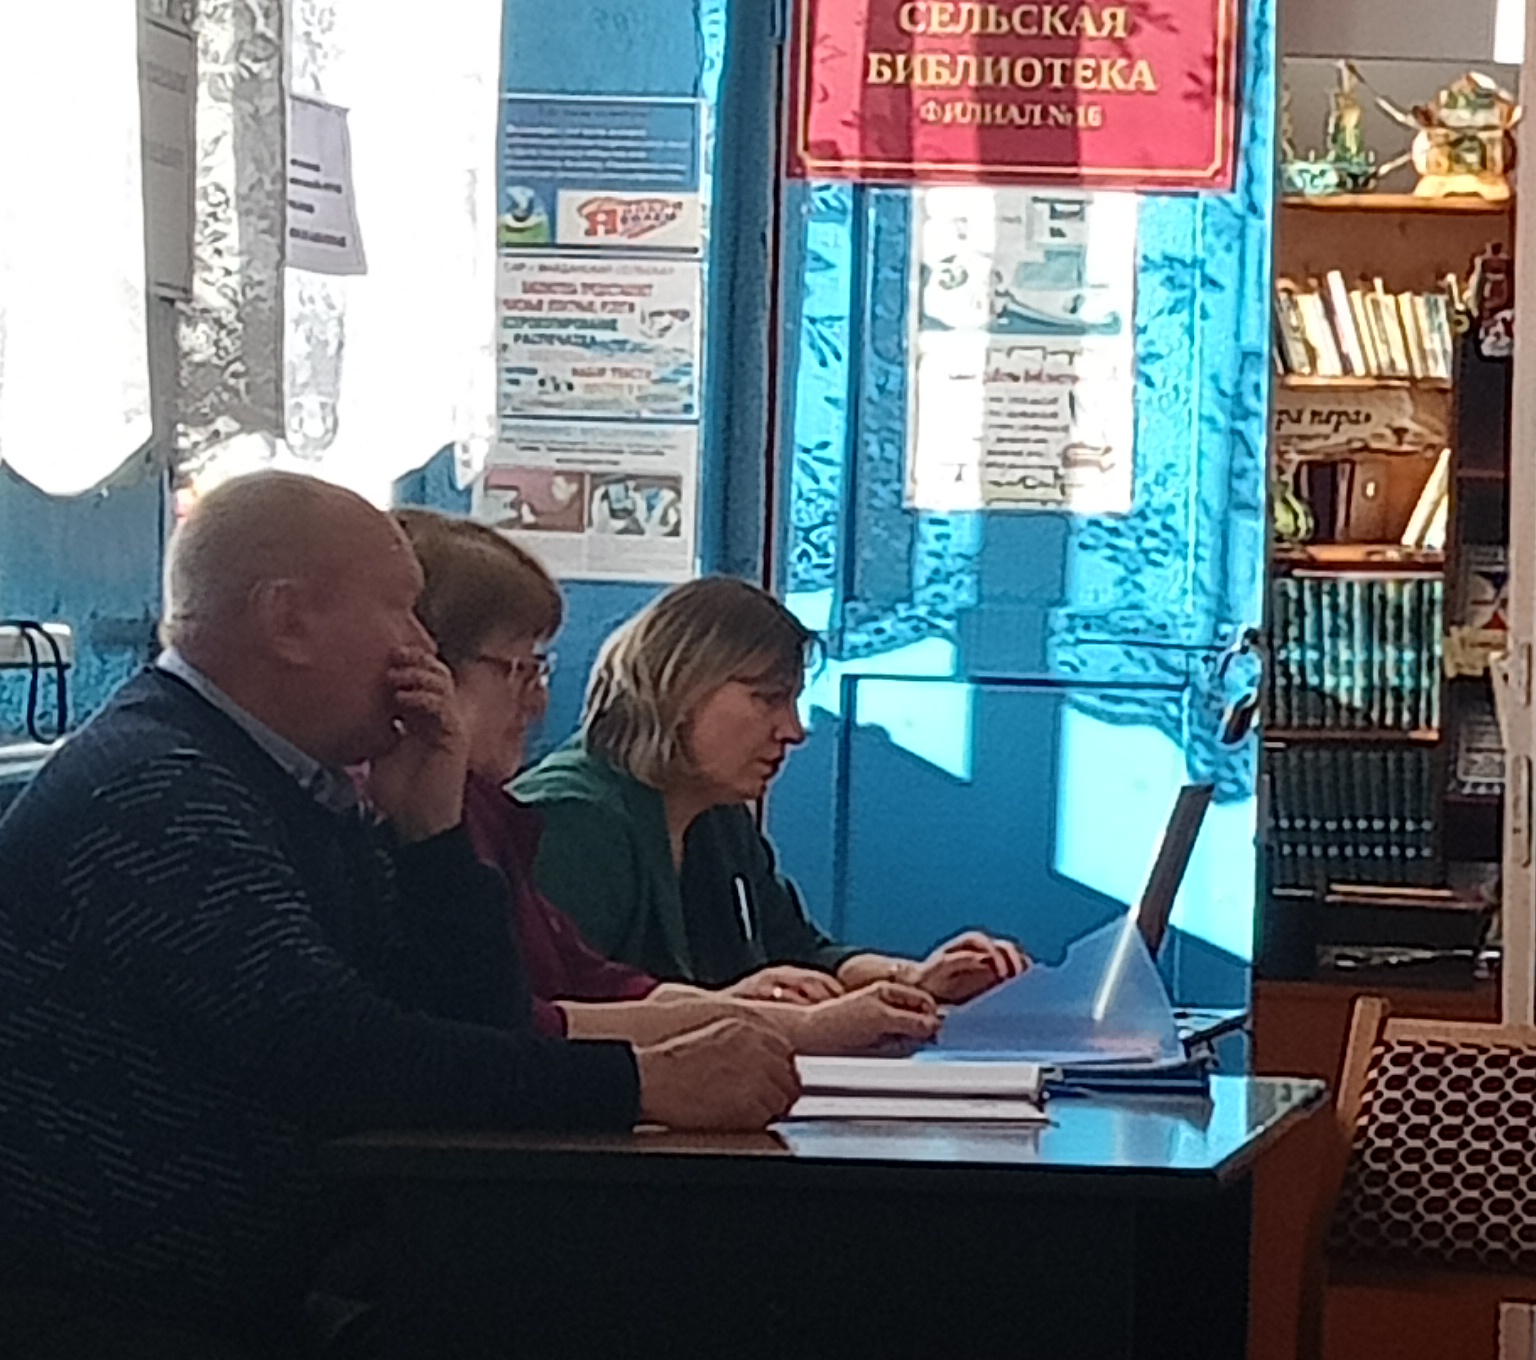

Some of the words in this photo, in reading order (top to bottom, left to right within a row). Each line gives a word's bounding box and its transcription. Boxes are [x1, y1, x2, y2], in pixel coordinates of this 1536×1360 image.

[898, 1, 1129, 39] СЕЛЬСКАЯ
[866, 52, 1157, 92] БИБЛИОТЕКА
[920, 104, 1041, 127] ФИЛИАЛ
